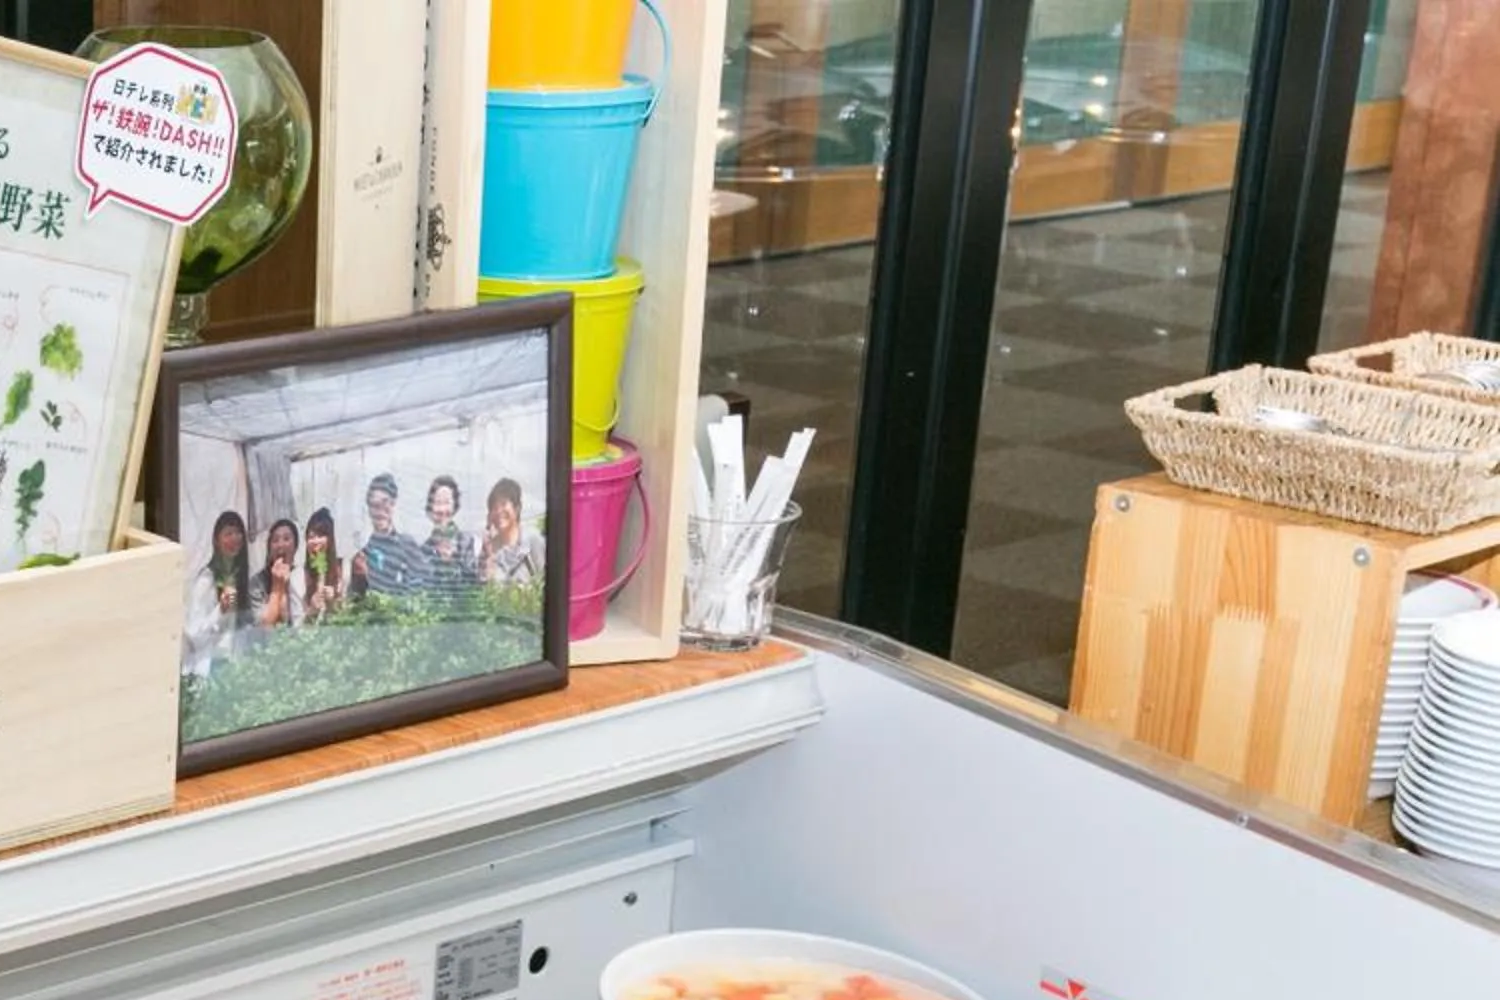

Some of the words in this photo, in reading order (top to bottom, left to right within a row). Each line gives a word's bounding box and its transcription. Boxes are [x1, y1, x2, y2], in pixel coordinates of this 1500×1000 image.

[113, 78, 176, 113] 日テレ系列
[93, 134, 215, 184] で紹介されました!
